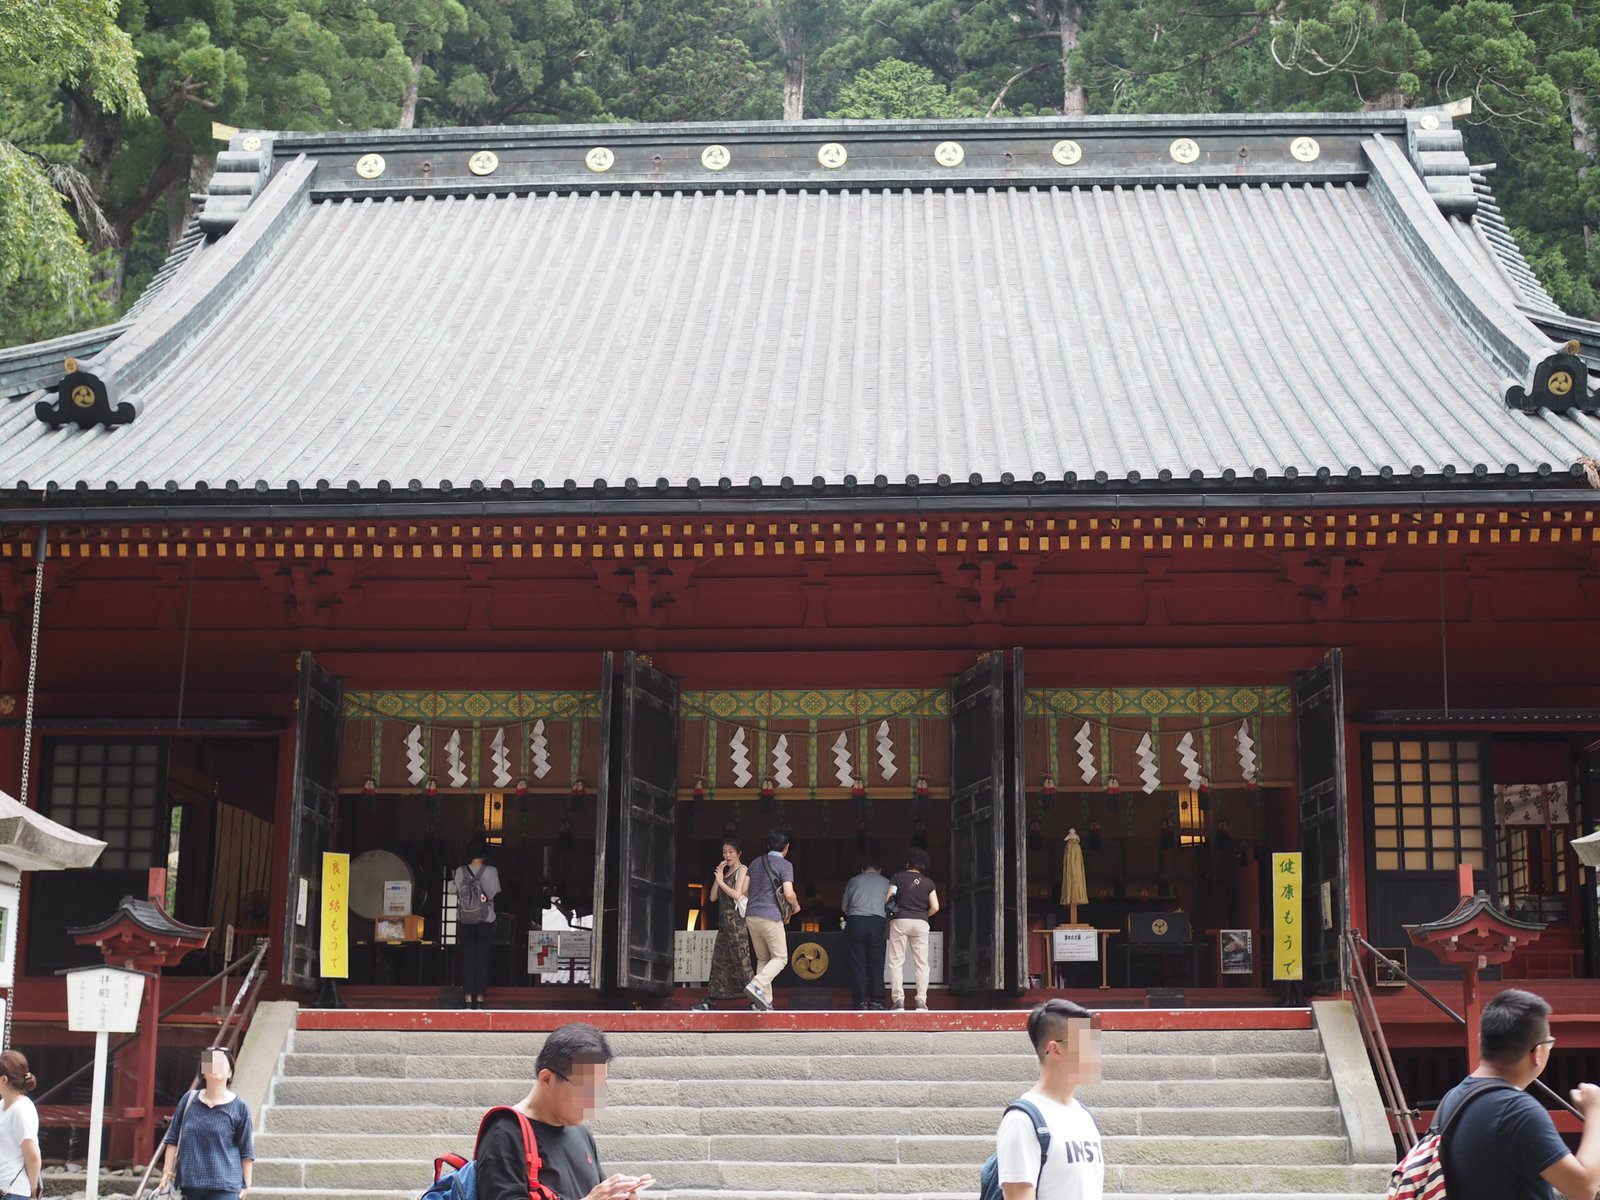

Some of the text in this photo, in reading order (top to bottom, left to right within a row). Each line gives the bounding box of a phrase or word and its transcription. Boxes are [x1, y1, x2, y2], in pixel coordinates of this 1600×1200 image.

[329, 860, 341, 968] 良い縁もうで
[1280, 858, 1296, 974] 健康もうで
[99, 975, 111, 999] 拝殿
